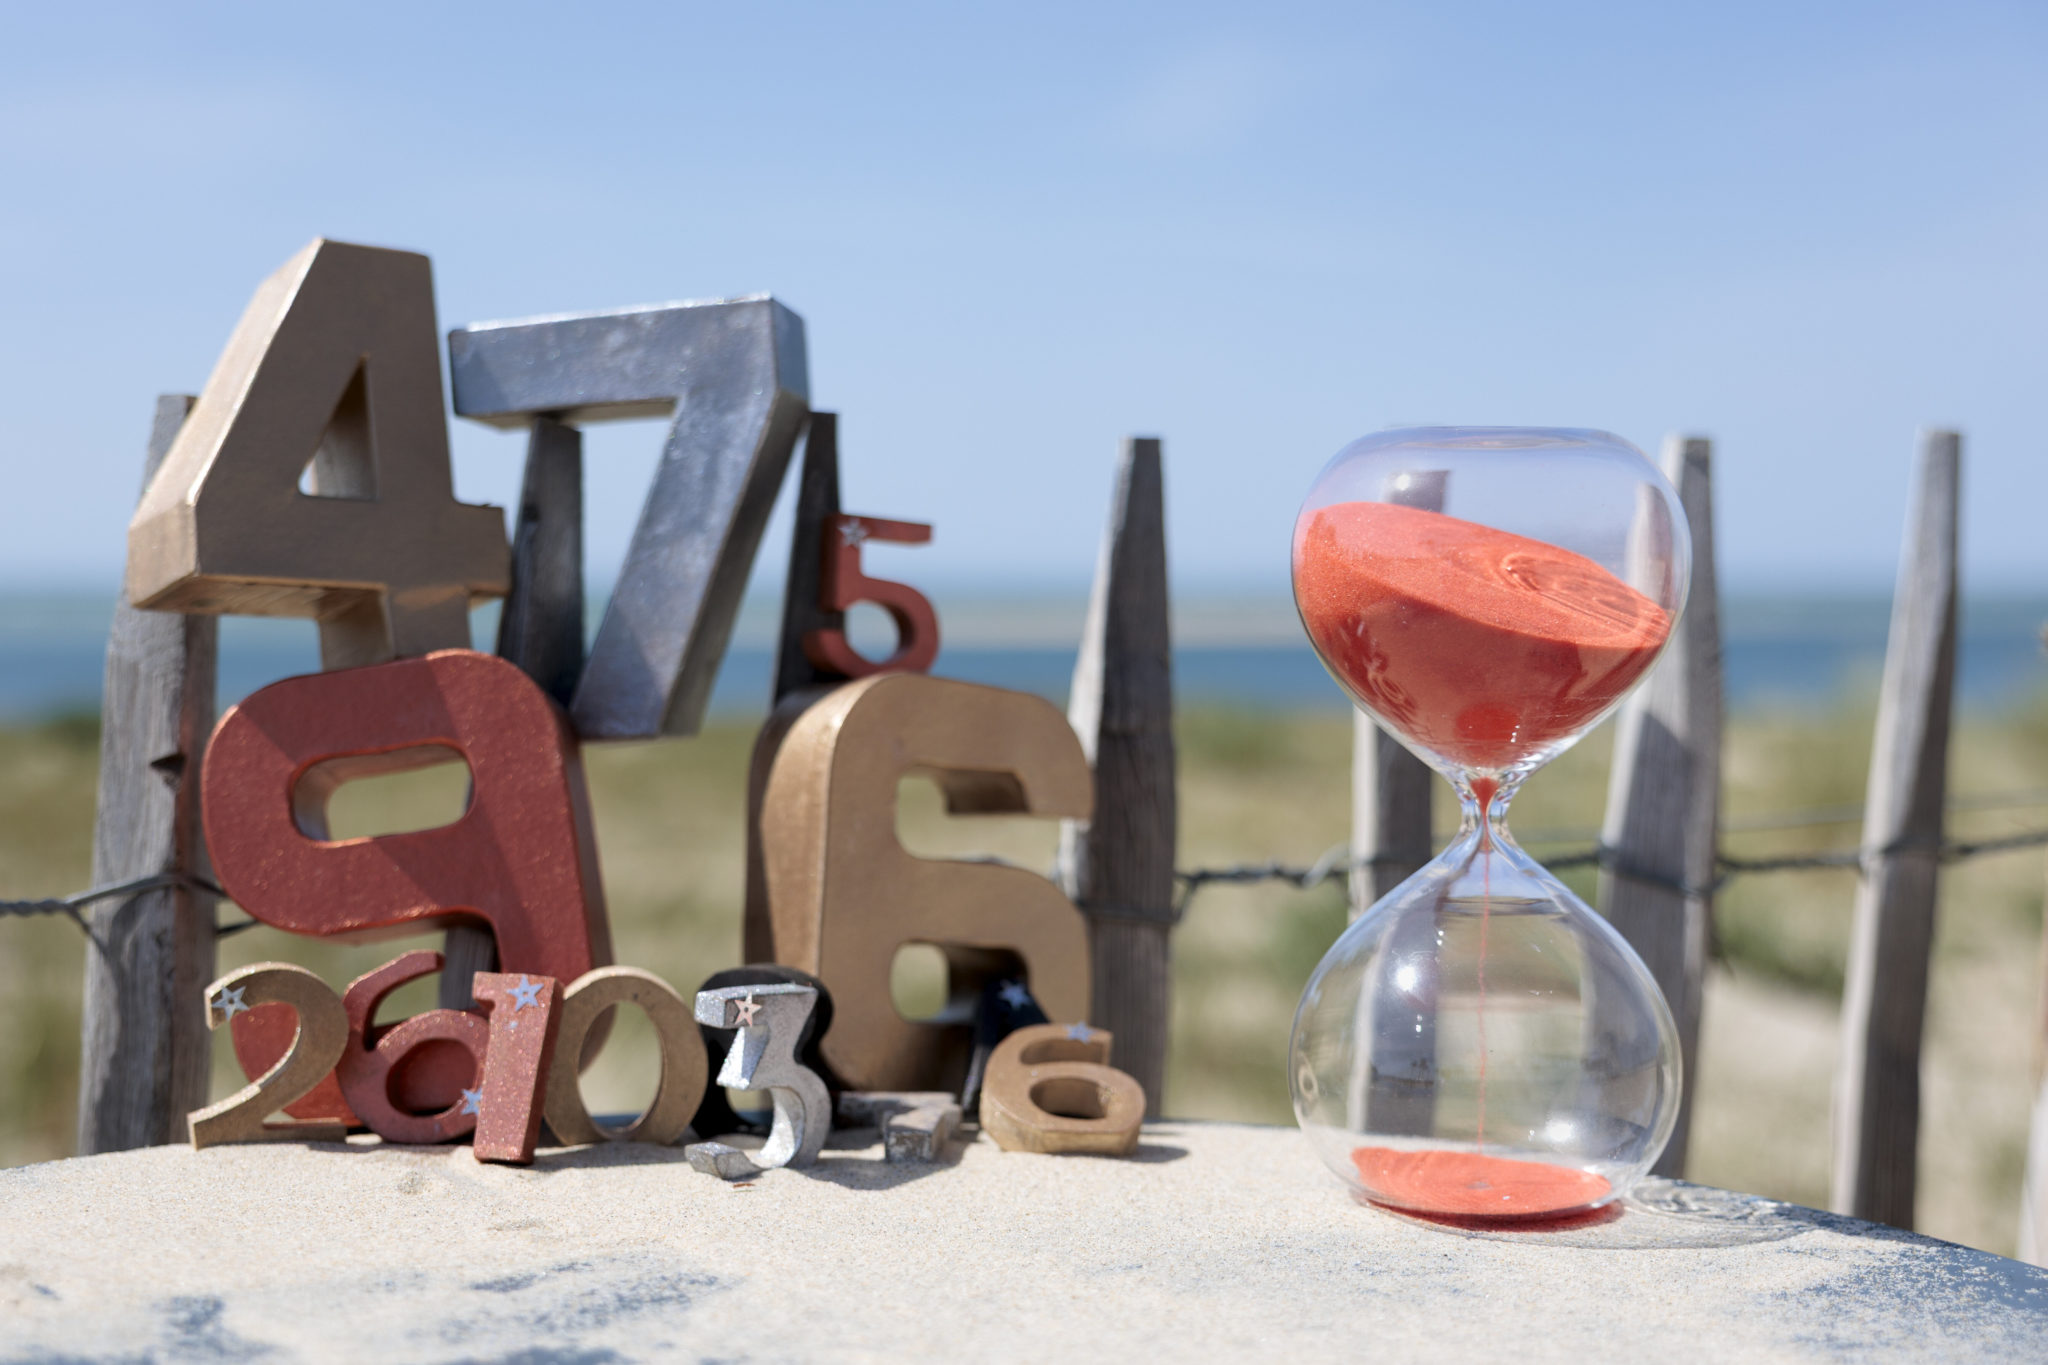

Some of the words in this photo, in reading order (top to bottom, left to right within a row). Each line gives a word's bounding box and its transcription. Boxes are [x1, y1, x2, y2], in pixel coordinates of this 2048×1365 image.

[128, 237, 511, 660] 4
[449, 292, 808, 742] 7
[805, 512, 939, 673] 5
[202, 648, 616, 1128] 9
[755, 672, 1096, 1091] 6
[187, 961, 348, 1150] 2
[338, 949, 488, 1144] 6
[472, 970, 563, 1166] 1
[685, 981, 831, 1180] 3
[979, 1022, 1146, 1155] 6
